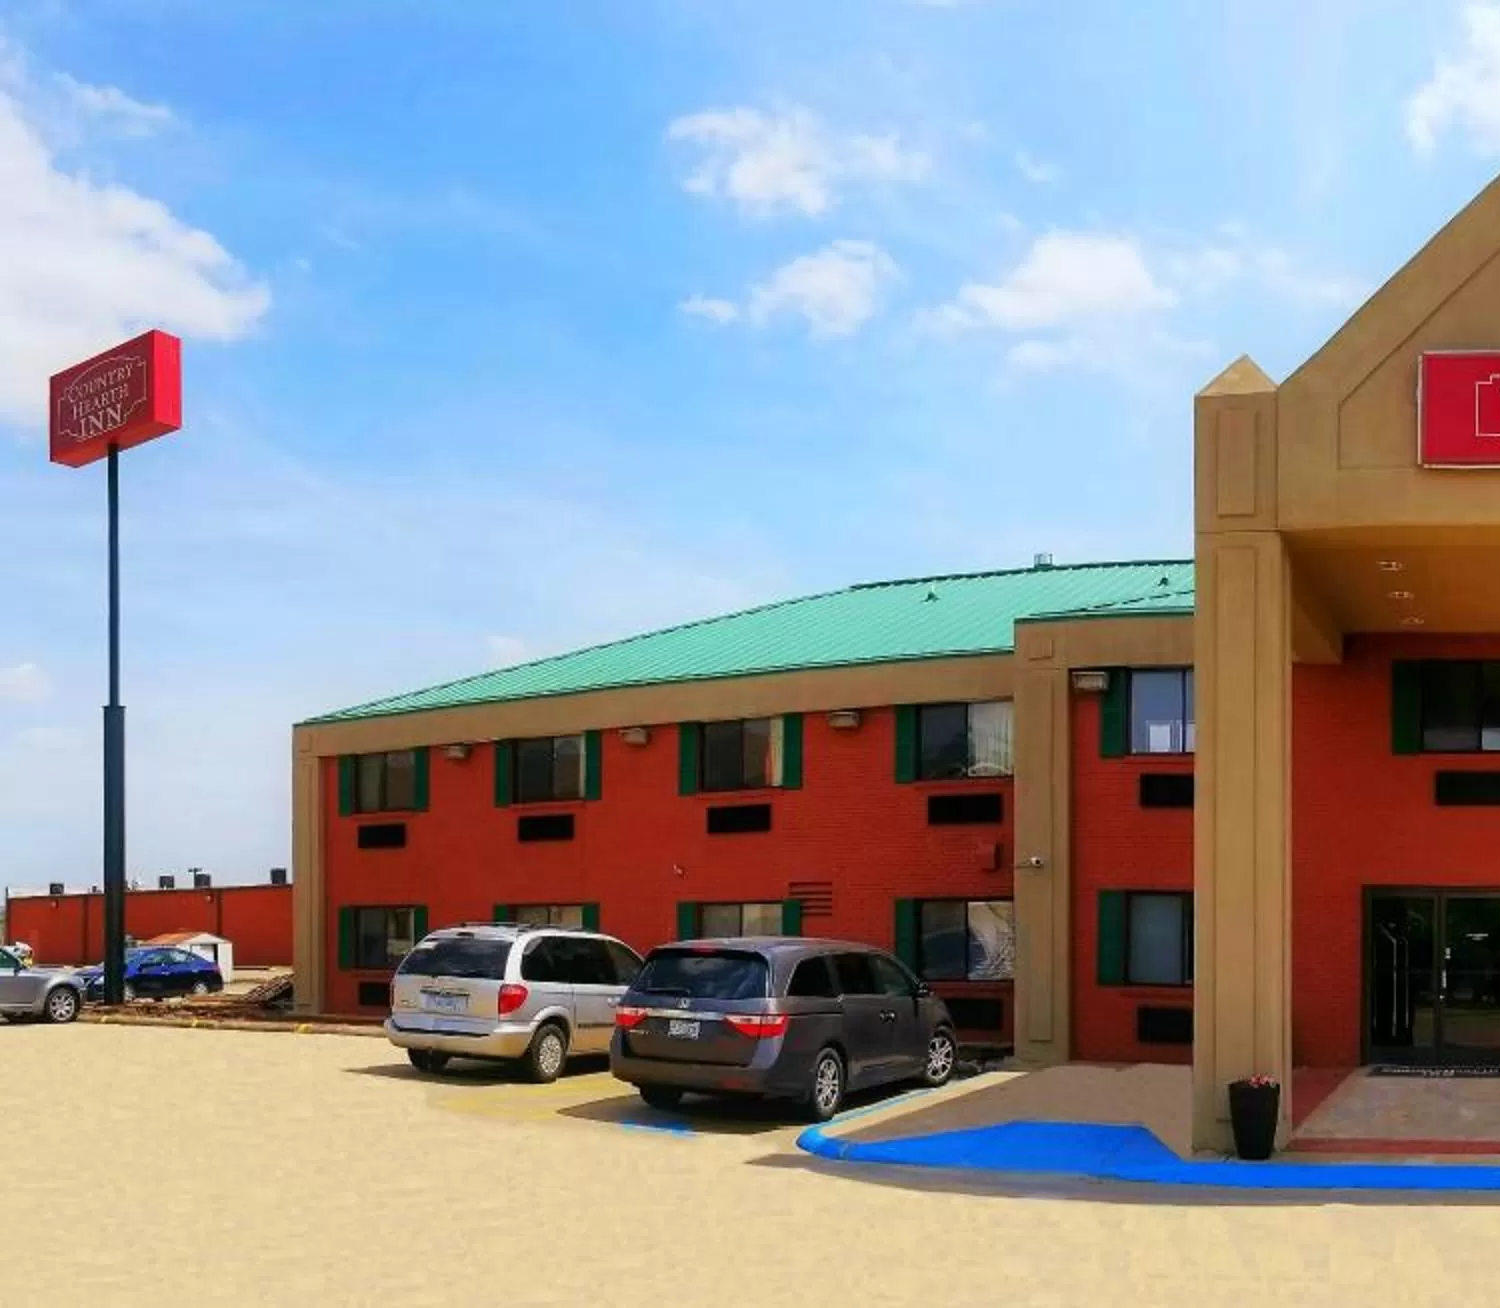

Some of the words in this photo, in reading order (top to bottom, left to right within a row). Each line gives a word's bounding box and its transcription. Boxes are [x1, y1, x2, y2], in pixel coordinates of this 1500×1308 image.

[67, 364, 134, 402] COUNTRY
[73, 383, 129, 420] HEARTH
[80, 404, 122, 437] INN
